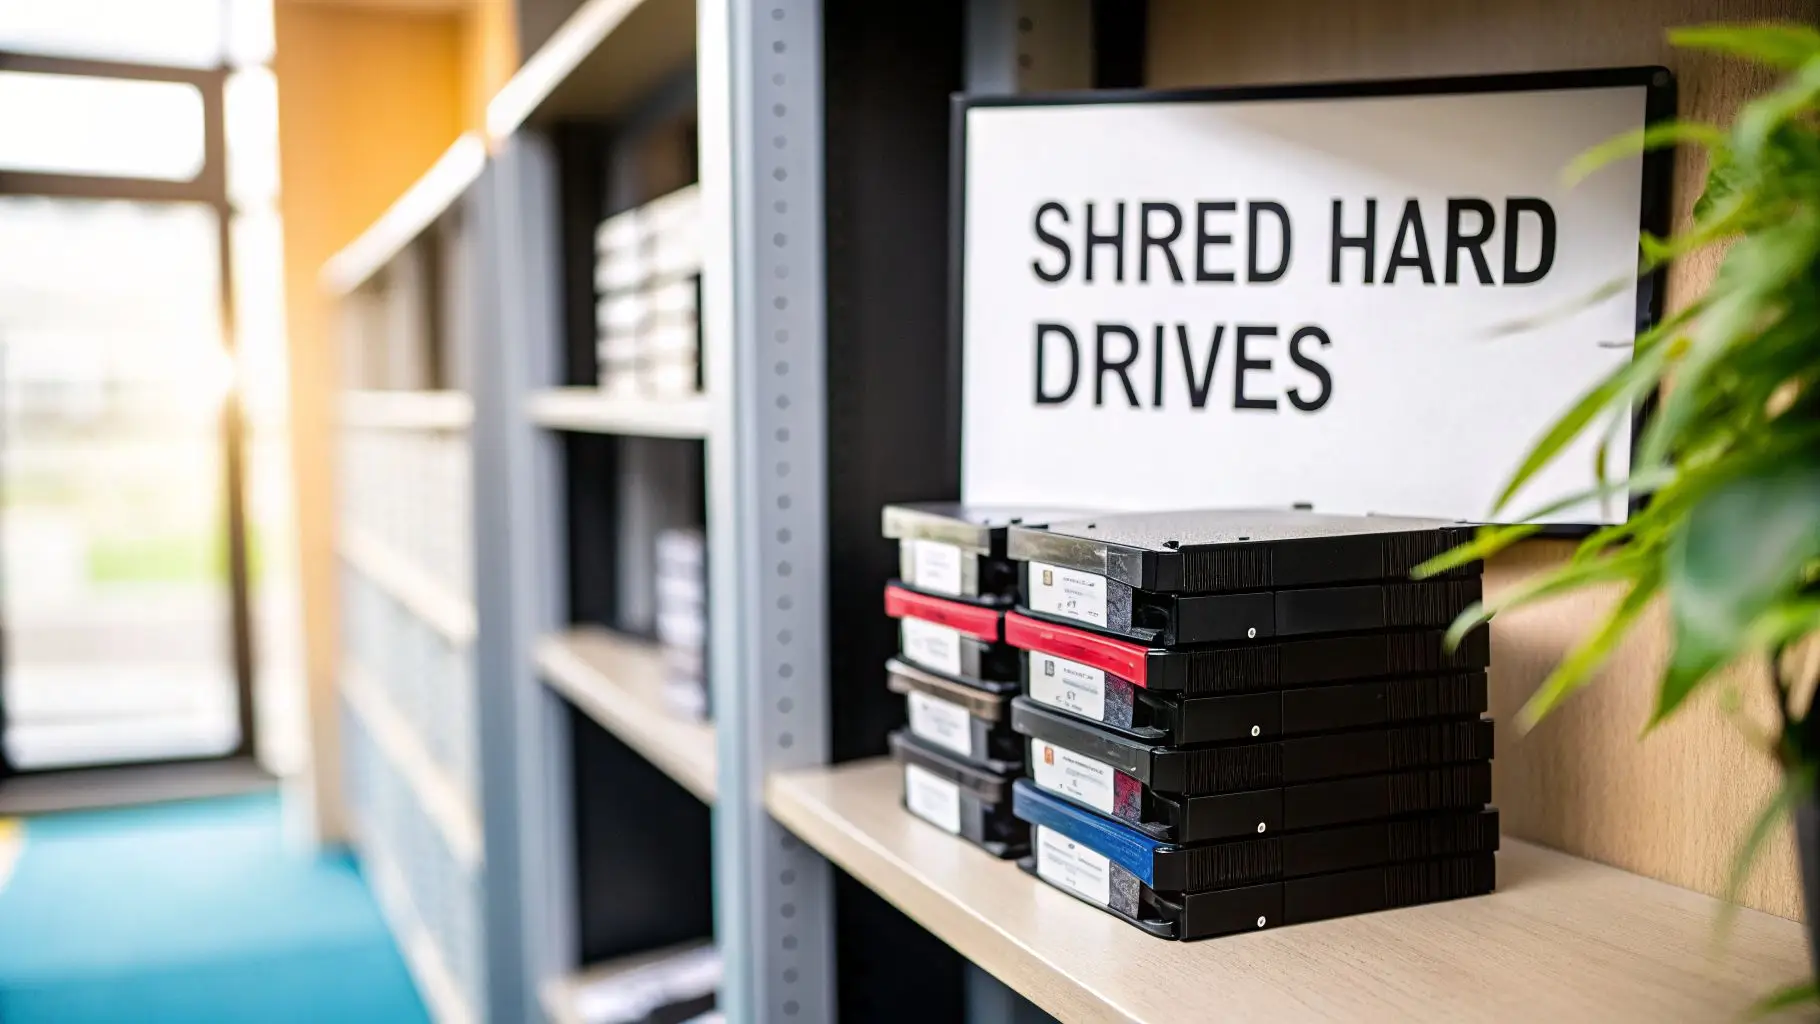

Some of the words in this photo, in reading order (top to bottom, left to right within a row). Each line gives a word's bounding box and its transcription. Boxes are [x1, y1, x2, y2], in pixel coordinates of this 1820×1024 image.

[1032, 200, 1292, 284] SHRED
[1331, 197, 1557, 285] HARD
[1035, 323, 1333, 412] DRIVES
